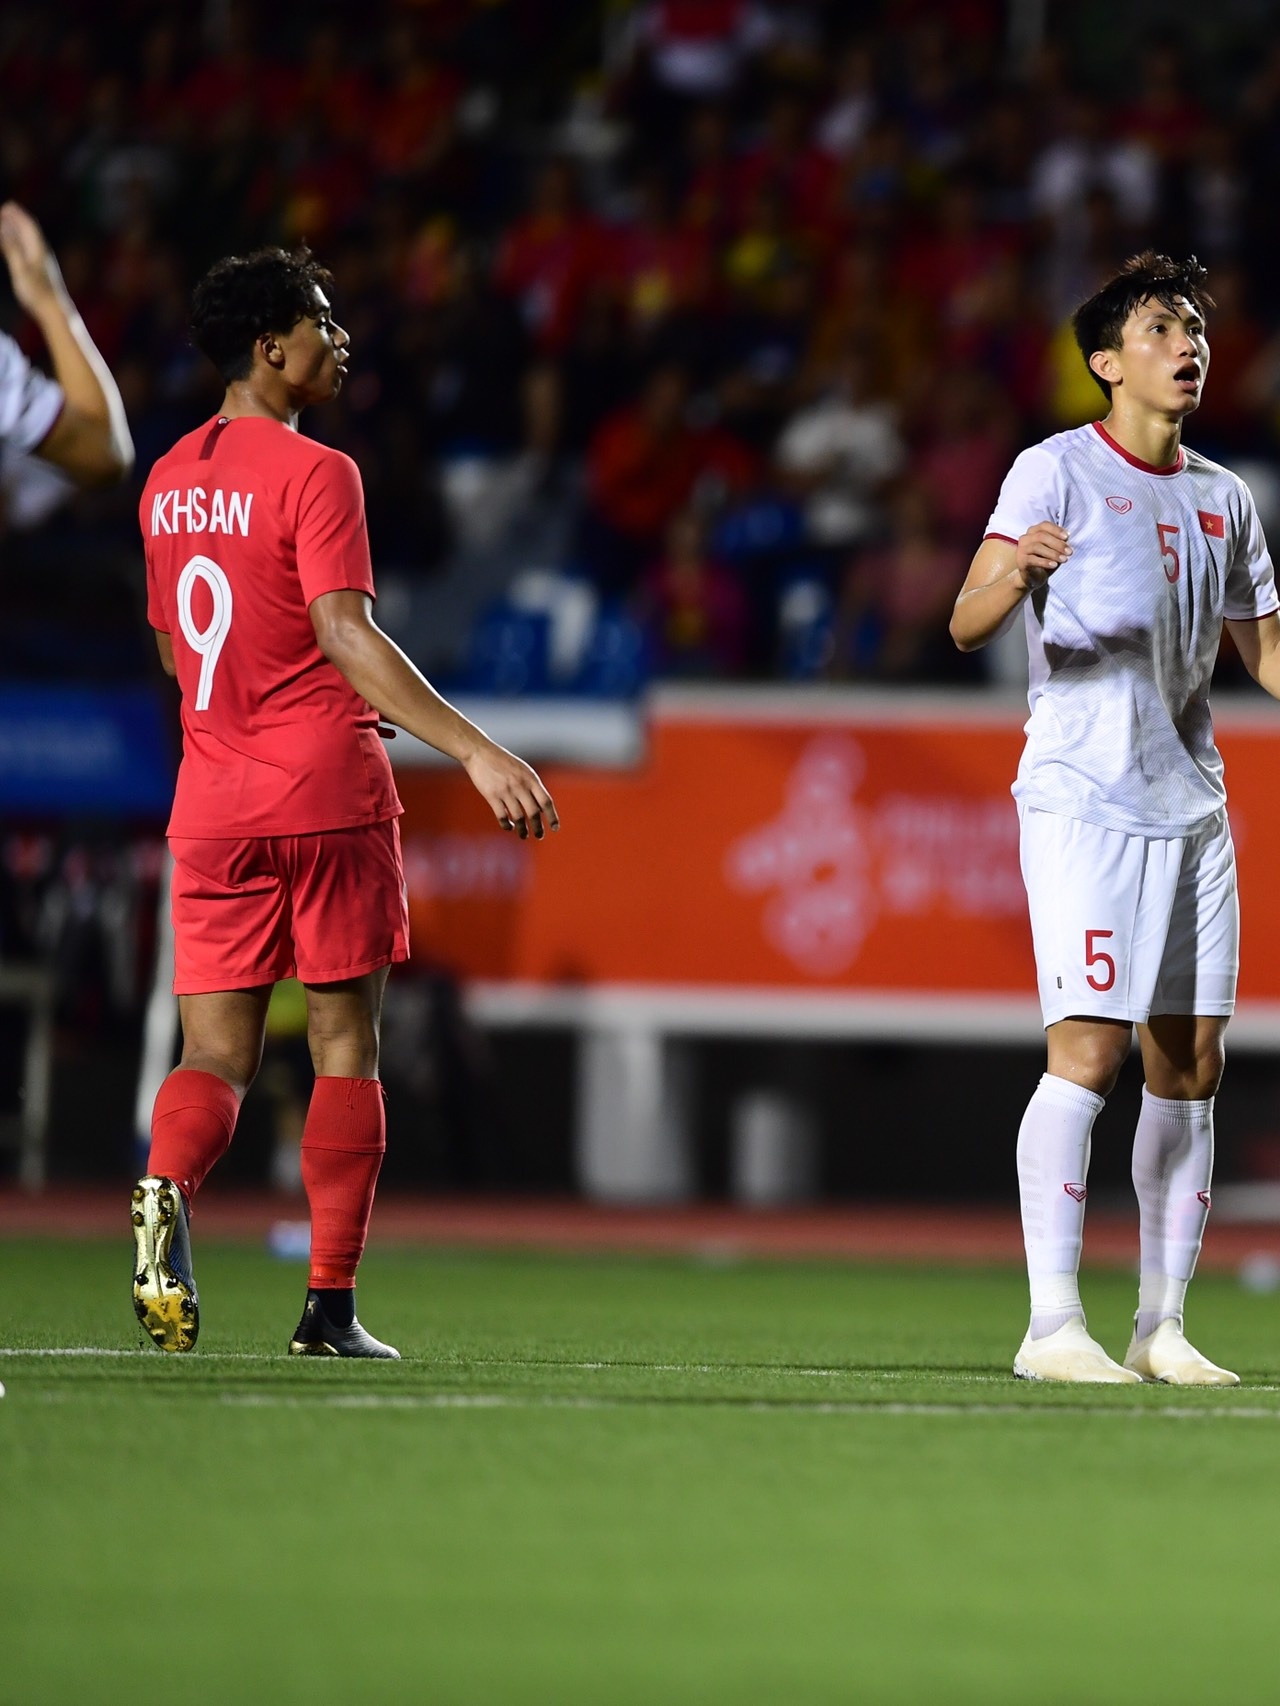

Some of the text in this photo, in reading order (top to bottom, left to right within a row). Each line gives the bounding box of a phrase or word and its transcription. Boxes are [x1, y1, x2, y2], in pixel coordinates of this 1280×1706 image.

[151, 486, 254, 538] IKHSAN
[1157, 522, 1180, 585] 5
[176, 554, 233, 711] 9
[1085, 929, 1116, 992] 5
